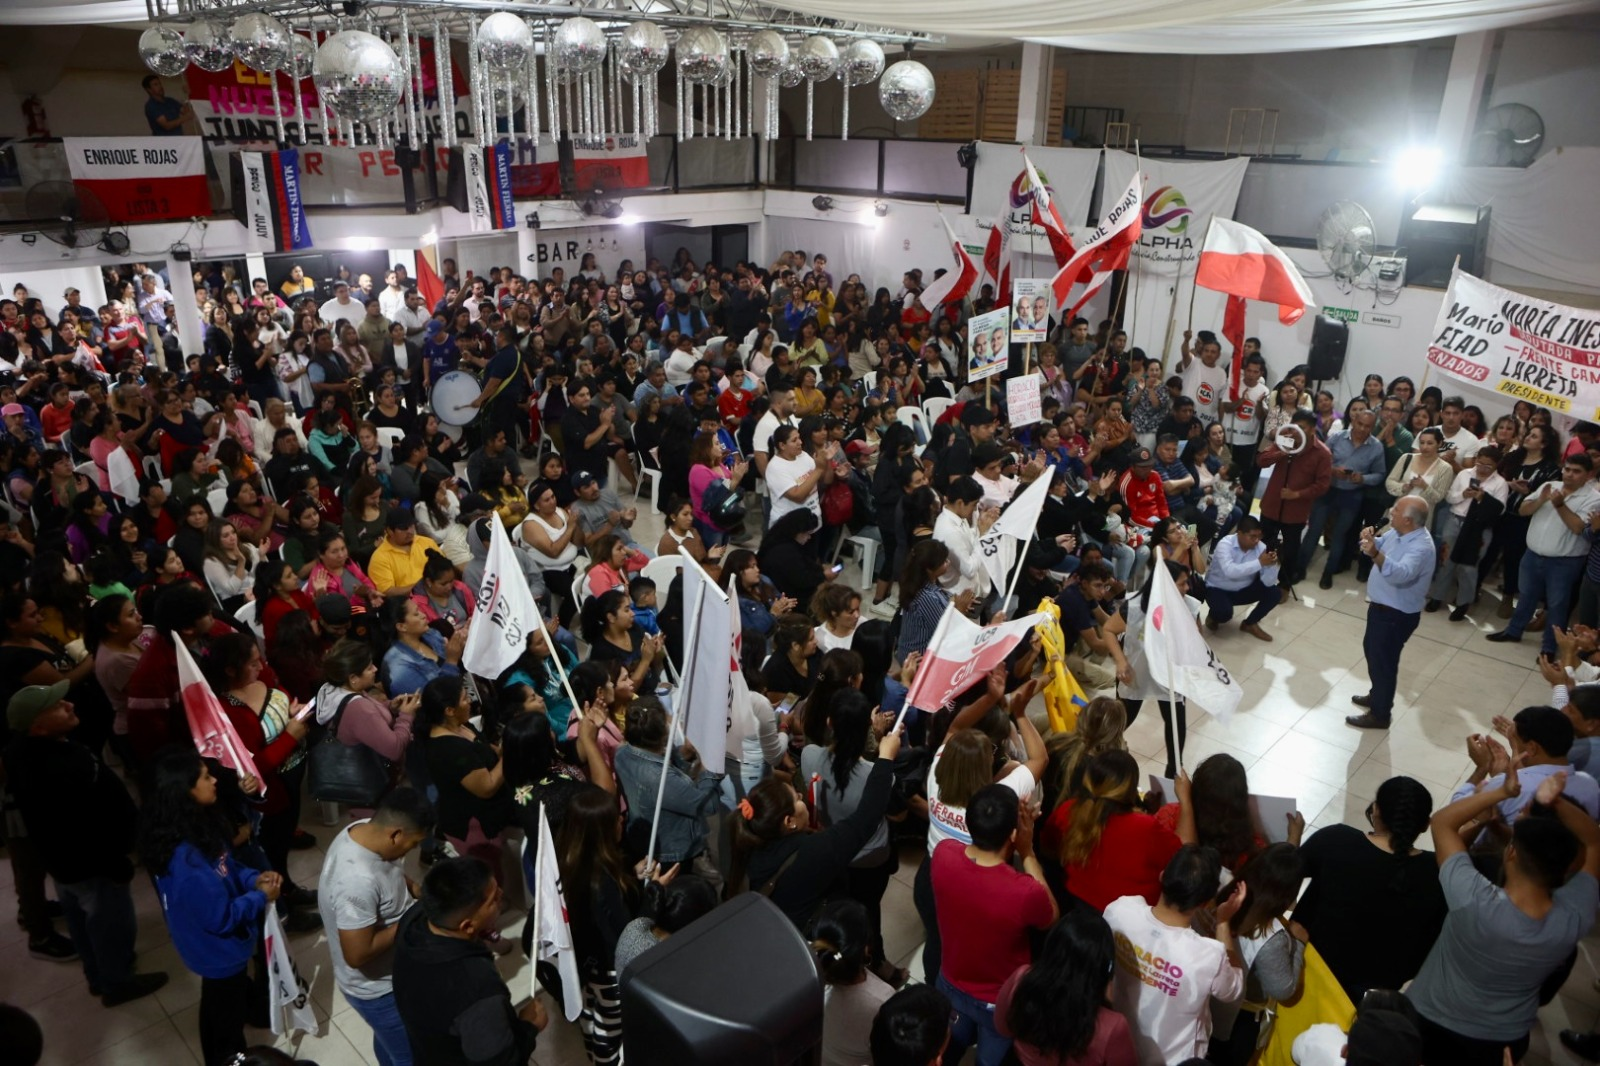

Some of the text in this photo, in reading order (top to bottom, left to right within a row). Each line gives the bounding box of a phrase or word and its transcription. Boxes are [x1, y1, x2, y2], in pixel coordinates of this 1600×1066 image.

[84, 149, 178, 165] ENRIQUE ROJAS
[537, 241, 579, 263] BAR
[1446, 302, 1504, 335] Mario
[1435, 326, 1489, 357] FIAD
[1519, 346, 1563, 375] FRENTE
[1501, 356, 1577, 397] LARRETA
[1501, 382, 1566, 410] PRESIDENTE
